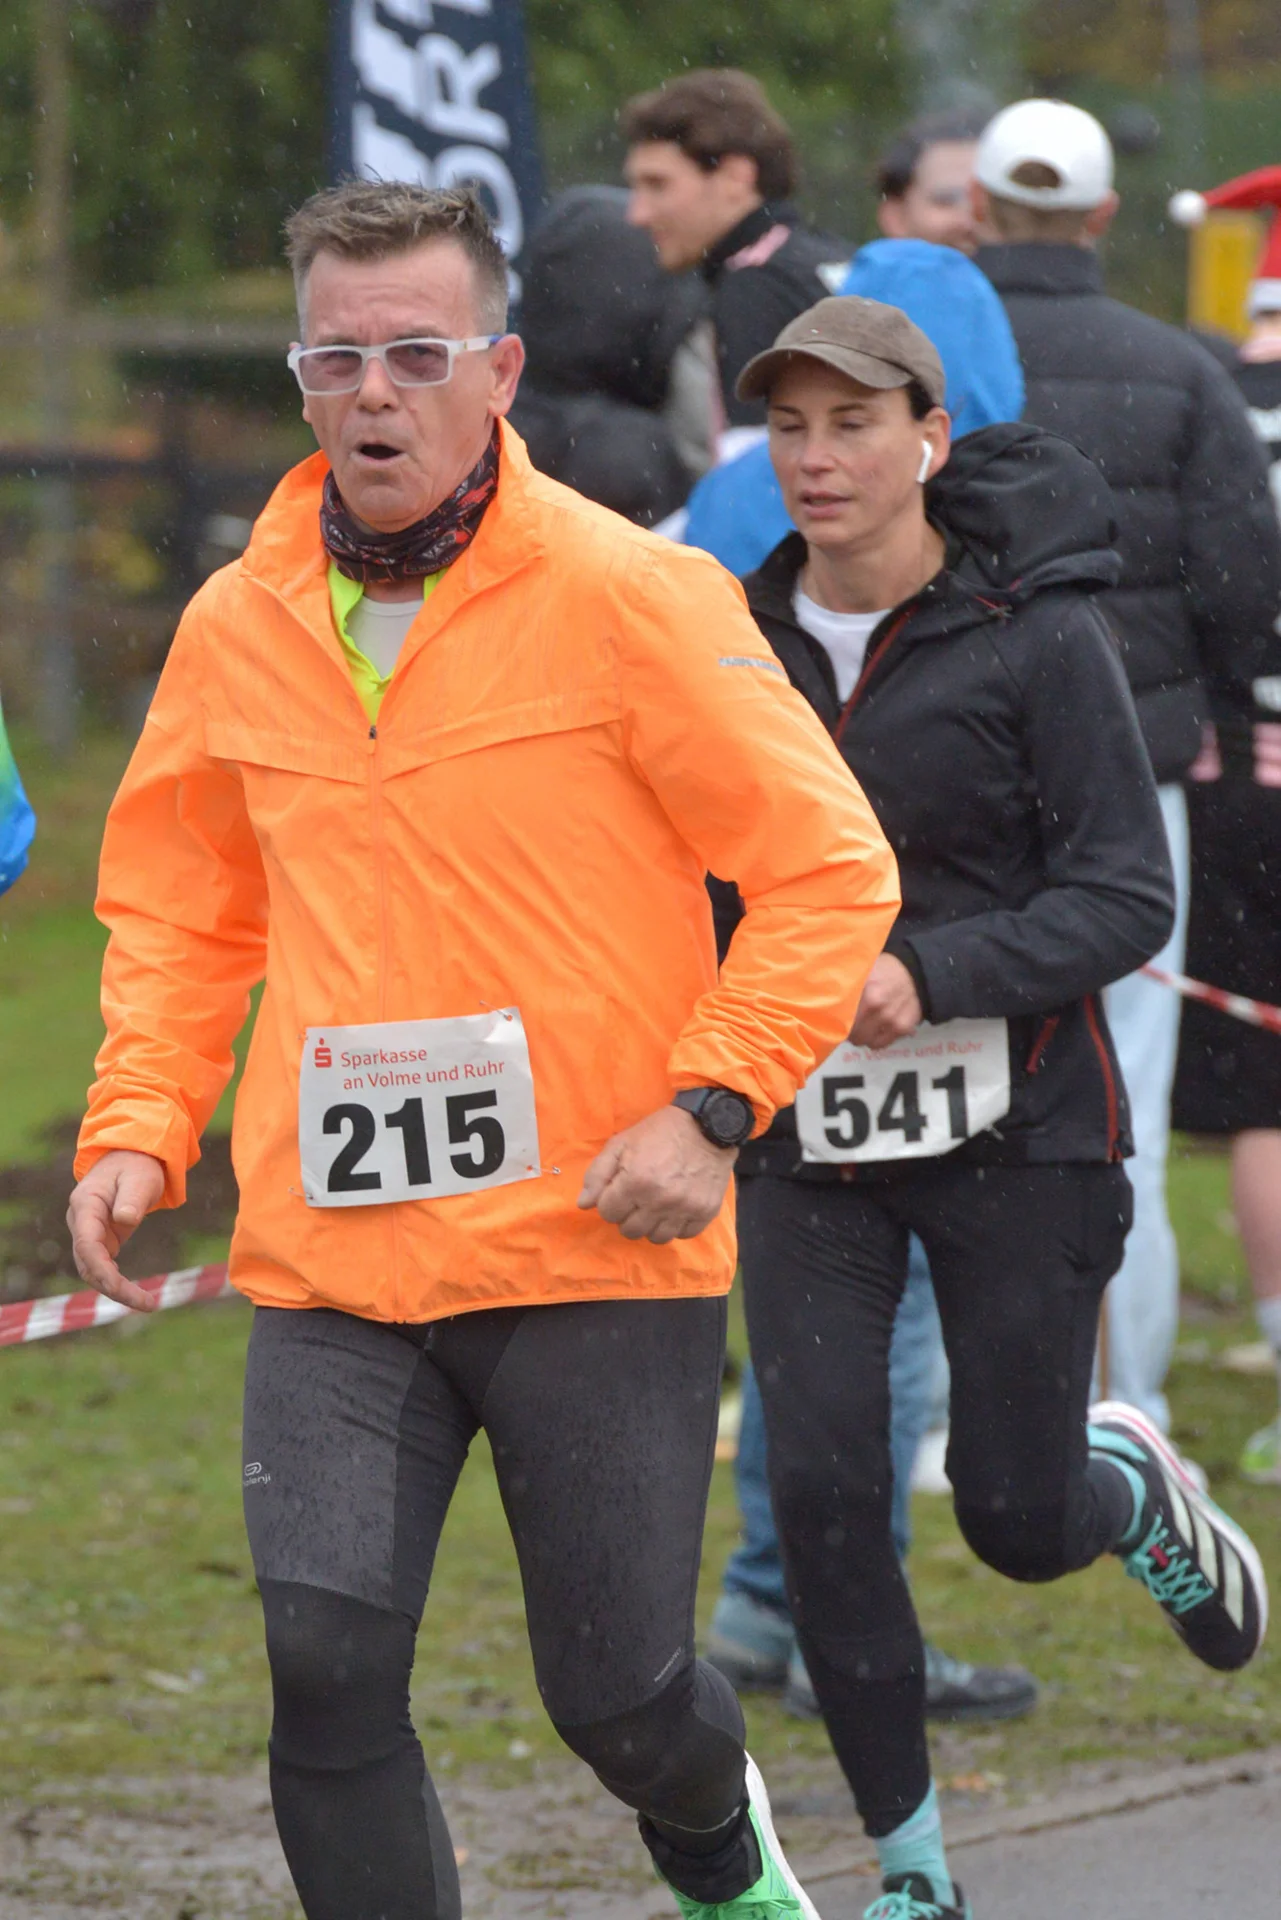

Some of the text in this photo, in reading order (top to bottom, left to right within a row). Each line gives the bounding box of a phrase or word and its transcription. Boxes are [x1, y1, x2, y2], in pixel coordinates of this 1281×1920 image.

[340, 1048, 427, 1070] Sparkasse
[915, 1042, 943, 1058] und
[947, 1039, 984, 1054] Ruhr
[343, 1060, 505, 1090] an Volme und Ruhr
[822, 1065, 970, 1149] 541
[322, 1089, 506, 1193] 215
